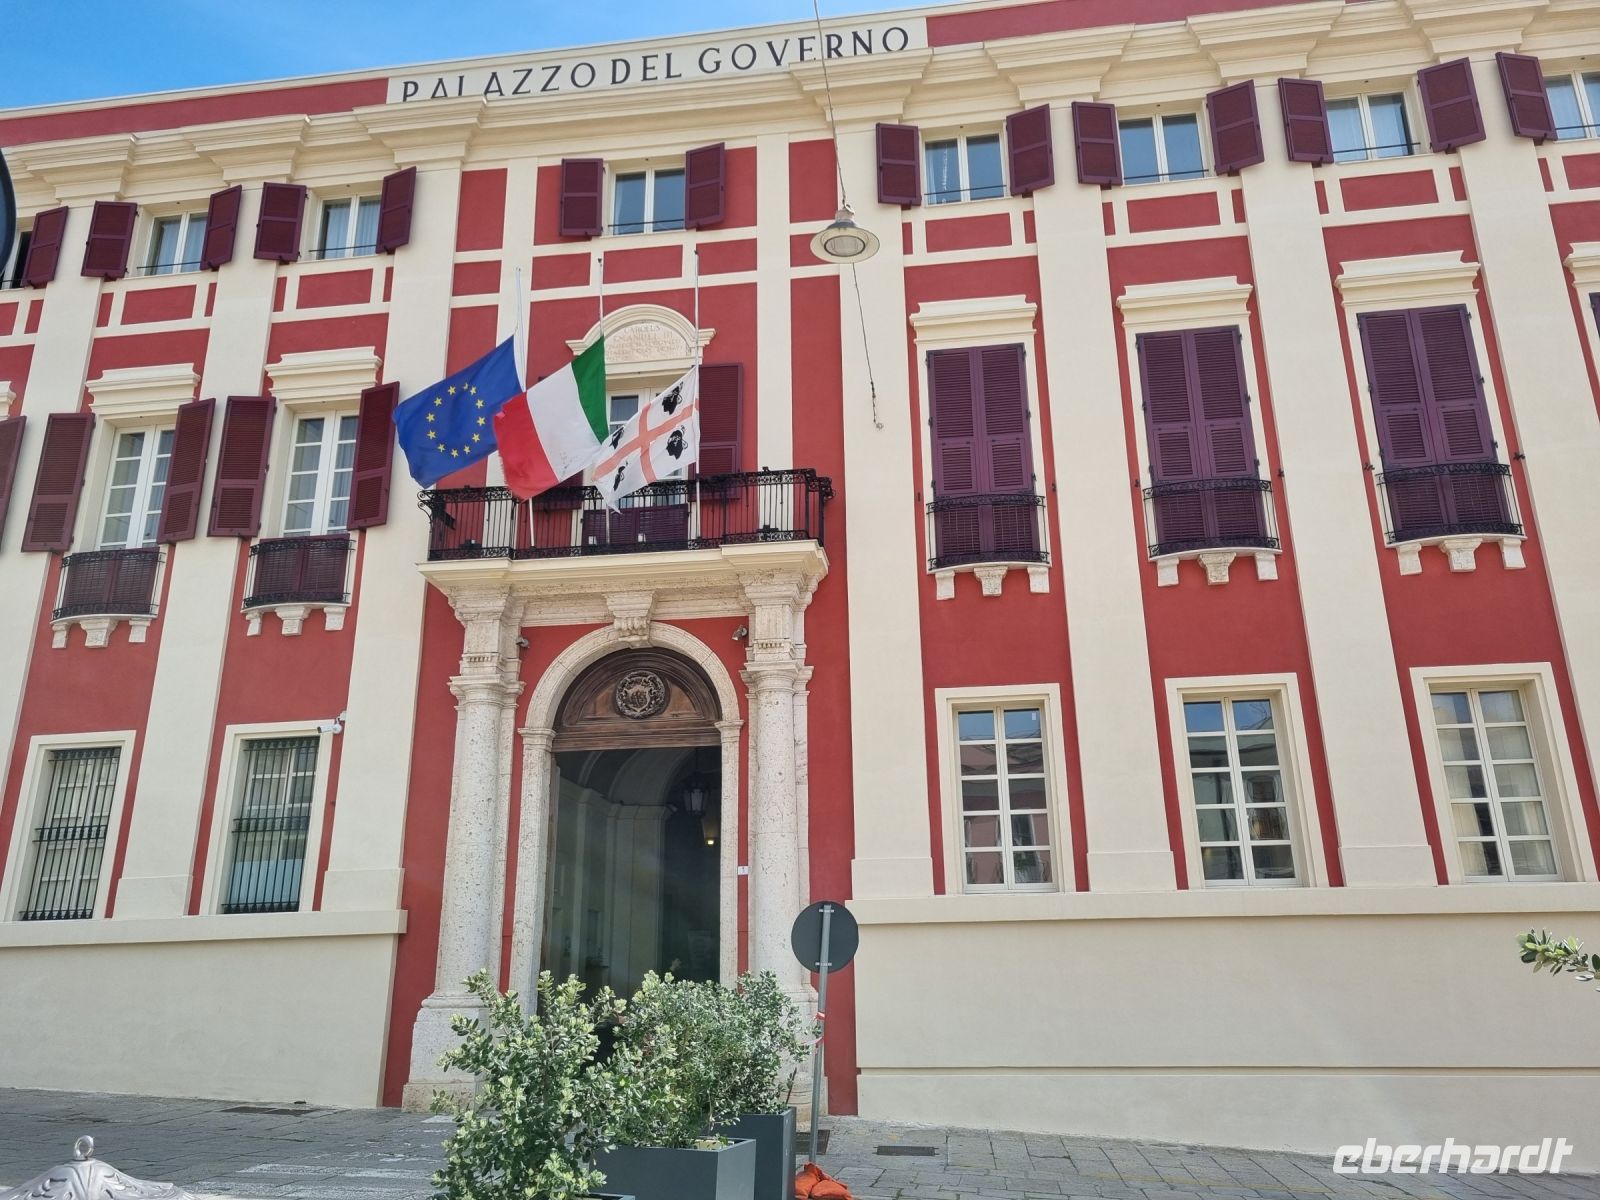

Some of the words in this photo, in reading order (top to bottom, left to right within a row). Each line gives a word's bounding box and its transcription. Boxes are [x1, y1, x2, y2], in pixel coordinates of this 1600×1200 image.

[402, 62, 597, 102] PALAZZO
[610, 52, 682, 85] DEL
[698, 26, 909, 74] GOVERNO
